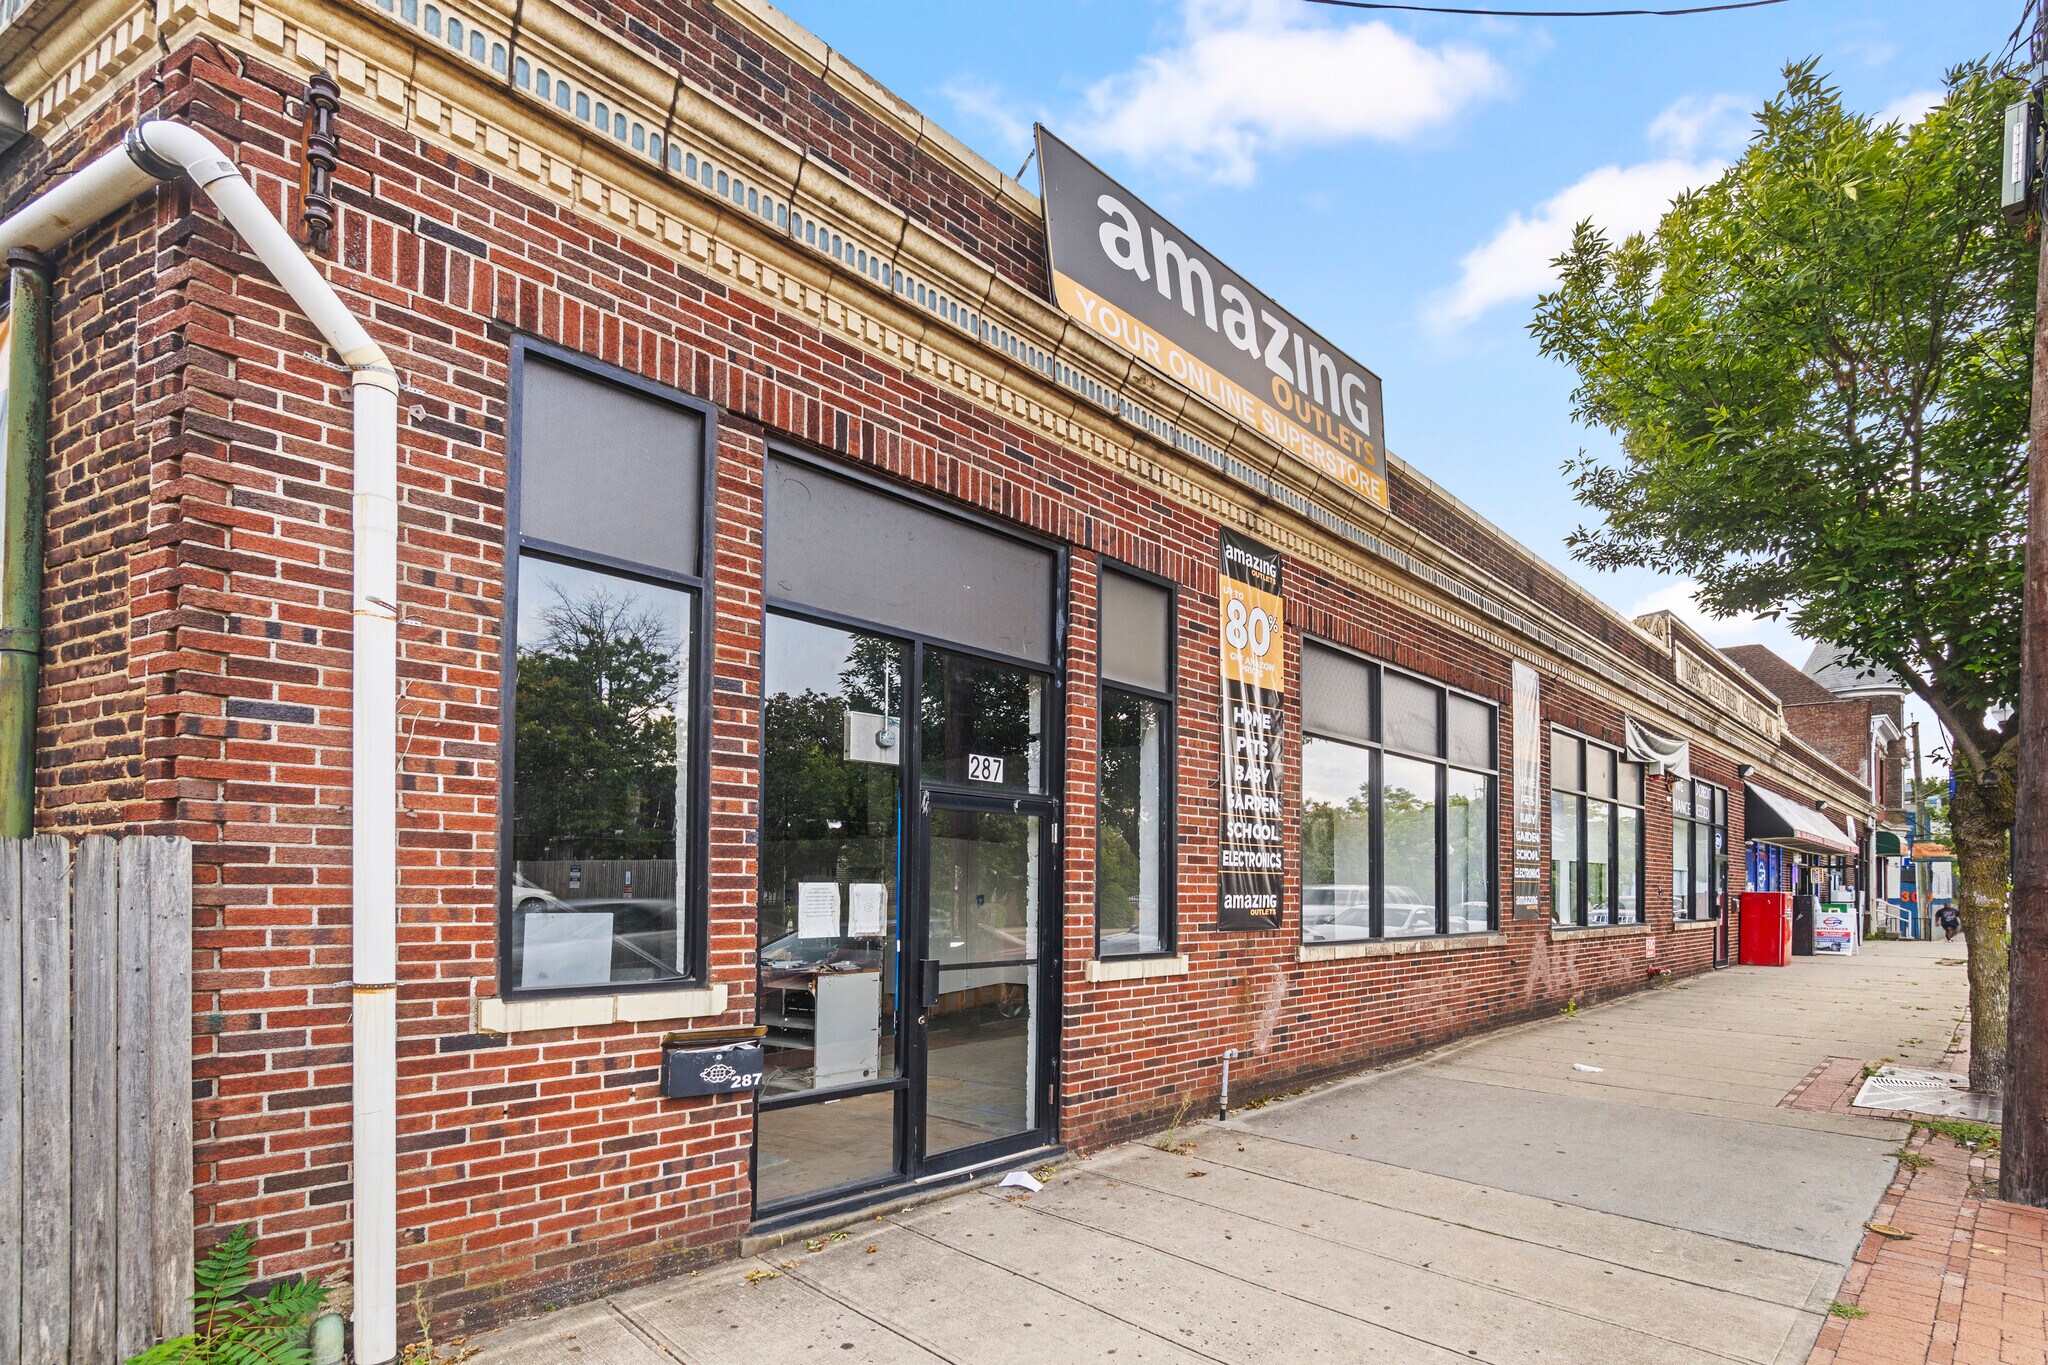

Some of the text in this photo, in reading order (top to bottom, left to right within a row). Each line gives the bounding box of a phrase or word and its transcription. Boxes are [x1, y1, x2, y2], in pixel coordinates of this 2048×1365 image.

[1075, 289, 1382, 503] YOUR ONLINE SUPERSTORE
[1272, 375, 1376, 466] OUTLETS
[1251, 569, 1277, 586] OUTLETS
[1234, 589, 1245, 600] TO
[1226, 597, 1279, 657] 80%
[1245, 656, 1275, 672] AMAZON
[1233, 706, 1271, 729] HOME
[1236, 737, 1269, 757] PETS
[970, 755, 1002, 781] 287
[1235, 764, 1271, 785] BABY
[1227, 793, 1279, 814] GARDEN
[1520, 812, 1537, 825] BABY
[1226, 821, 1279, 841] SCHOOL
[1516, 830, 1540, 843] GARDEN
[1222, 850, 1282, 869] ELECTRONICS
[1515, 849, 1540, 861] SCHOOL
[1250, 907, 1277, 916] OUTLETS
[730, 1072, 763, 1089] 287
